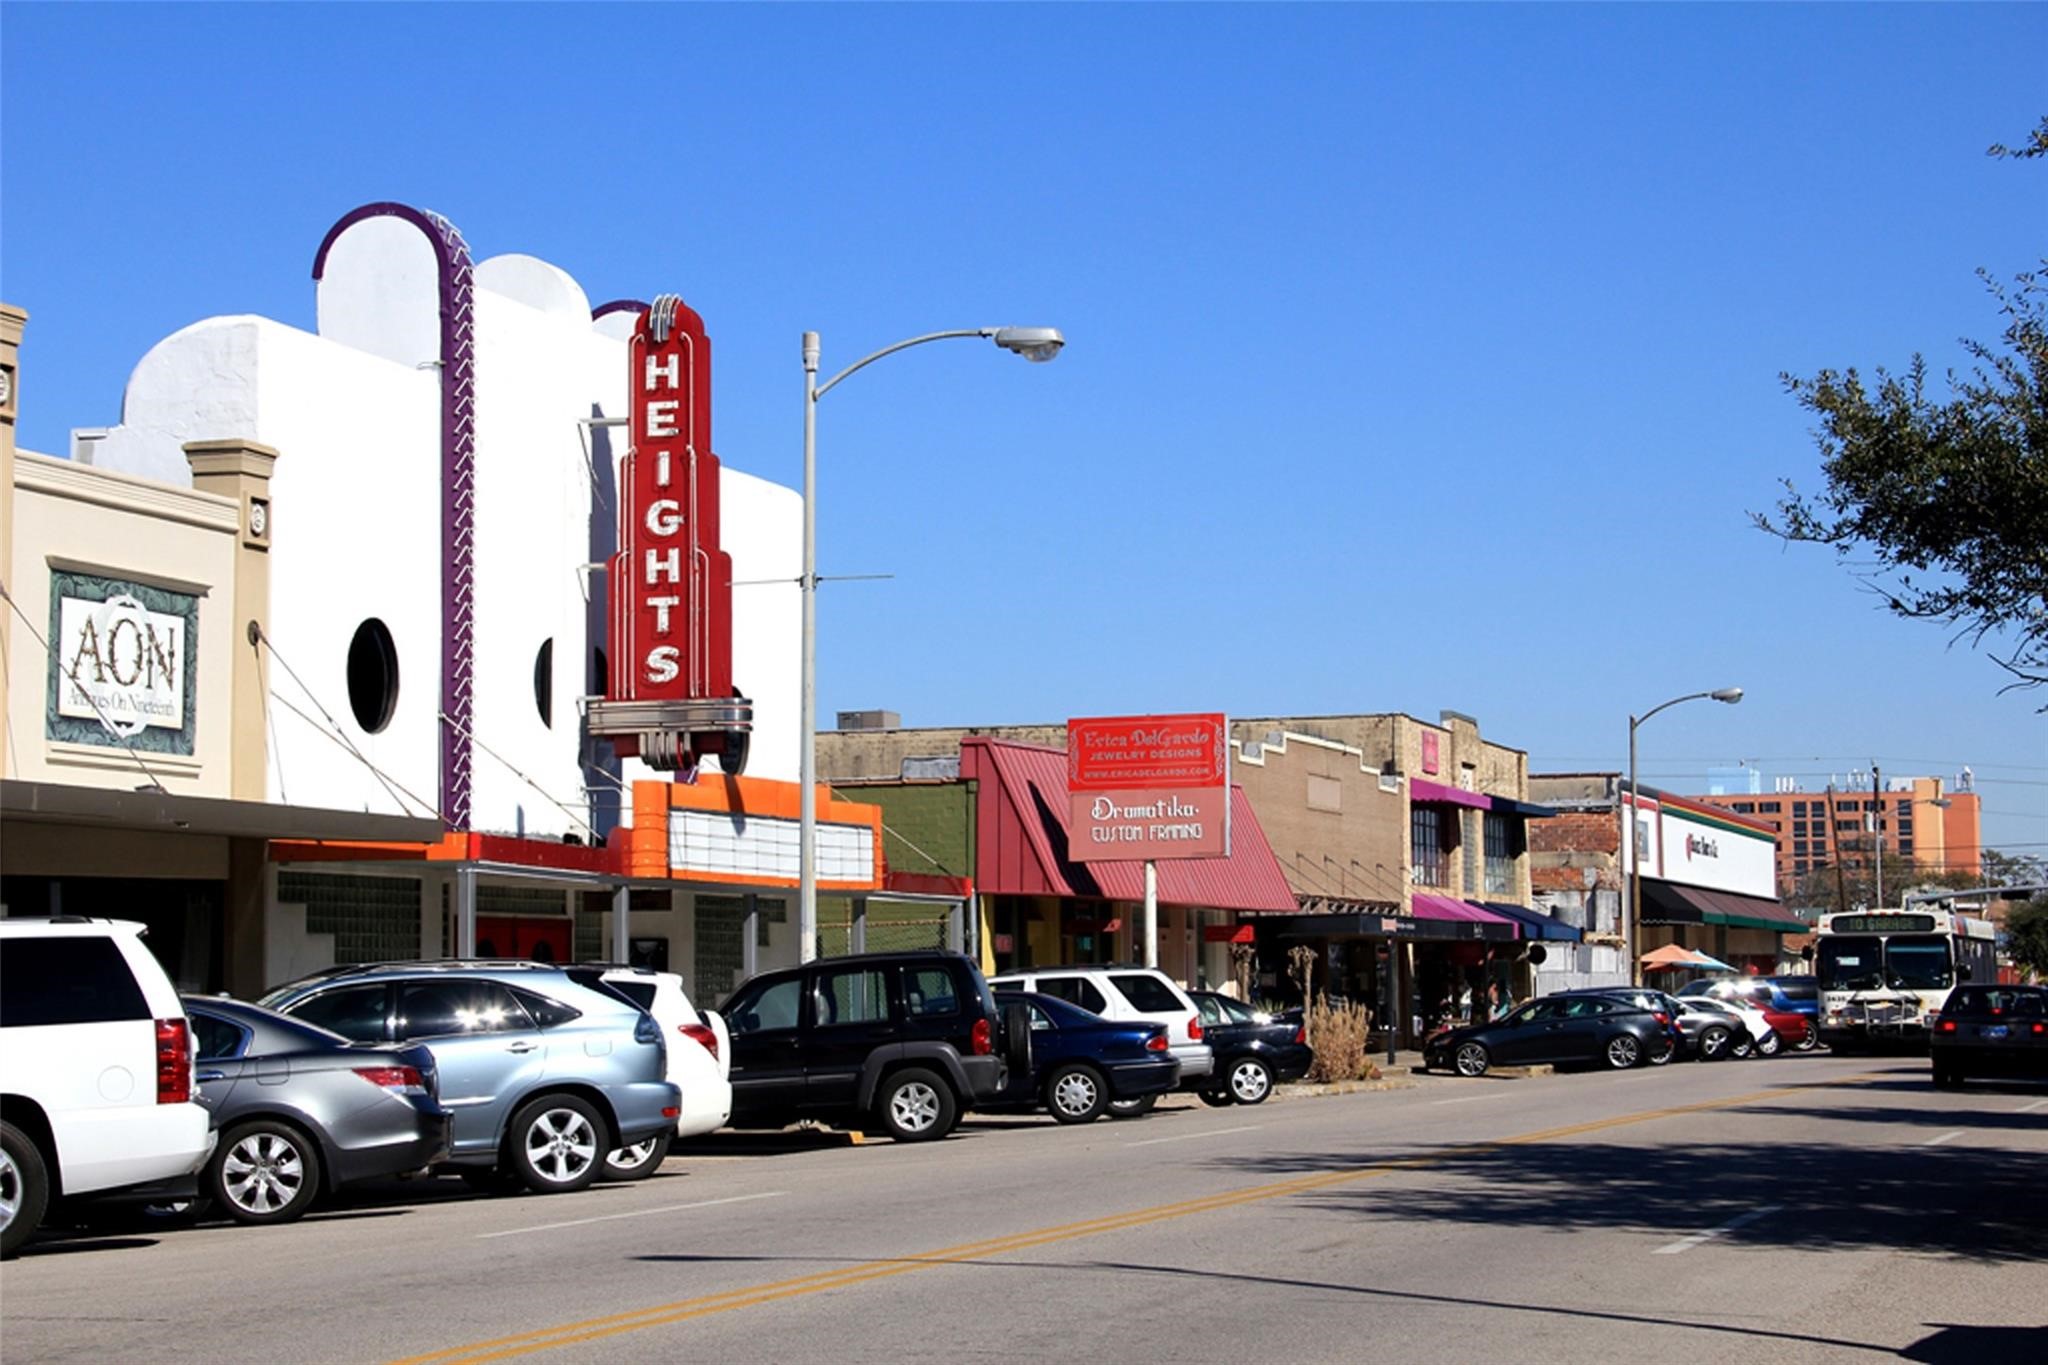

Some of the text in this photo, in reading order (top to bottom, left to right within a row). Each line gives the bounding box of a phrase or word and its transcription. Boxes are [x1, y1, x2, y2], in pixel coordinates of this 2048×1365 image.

[644, 353, 685, 684] HEIGHTS
[70, 615, 175, 692] AON
[1090, 748, 1202, 761] JEWELRY DESIGNS
[1091, 822, 1203, 842] CUSTOM FRAMING
